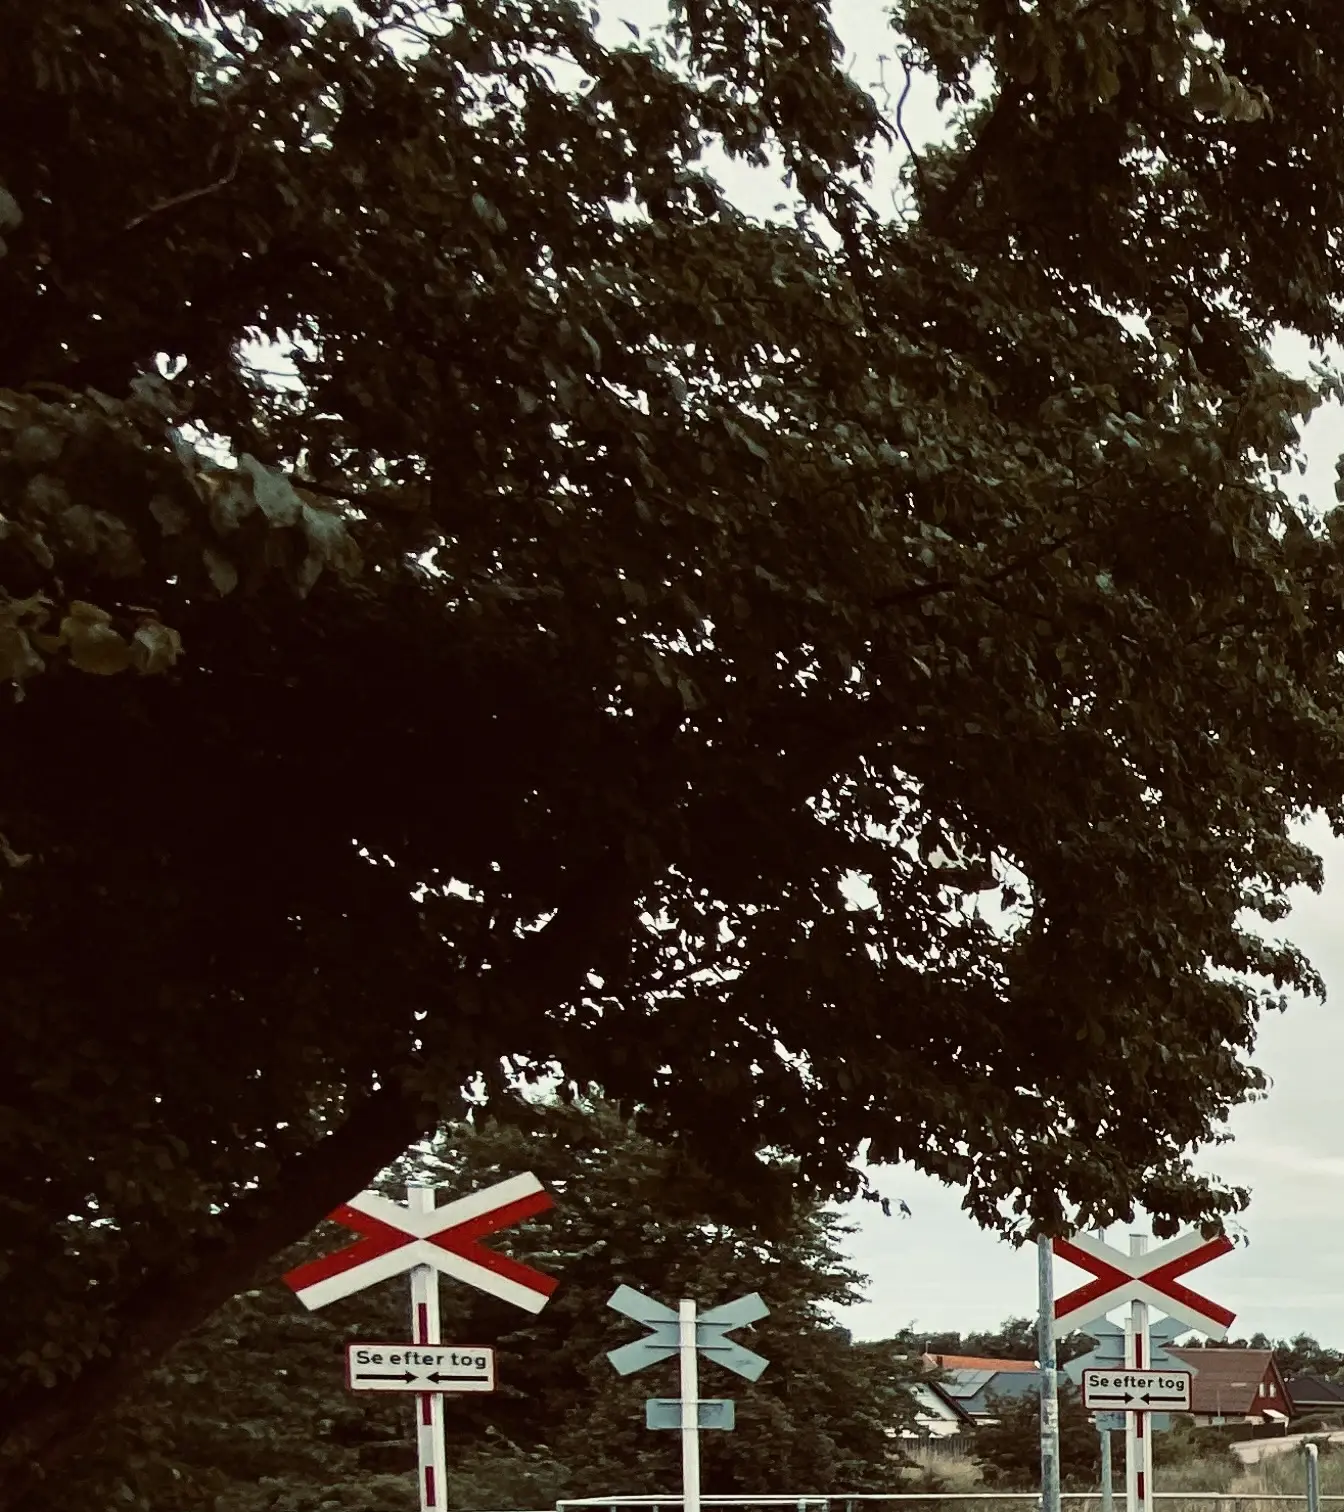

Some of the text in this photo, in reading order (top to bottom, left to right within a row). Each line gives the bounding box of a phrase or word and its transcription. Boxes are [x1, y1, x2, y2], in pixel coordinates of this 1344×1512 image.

[356, 1350, 487, 1370] Se efter tog
[1089, 1375, 1185, 1391] Se efter tog
